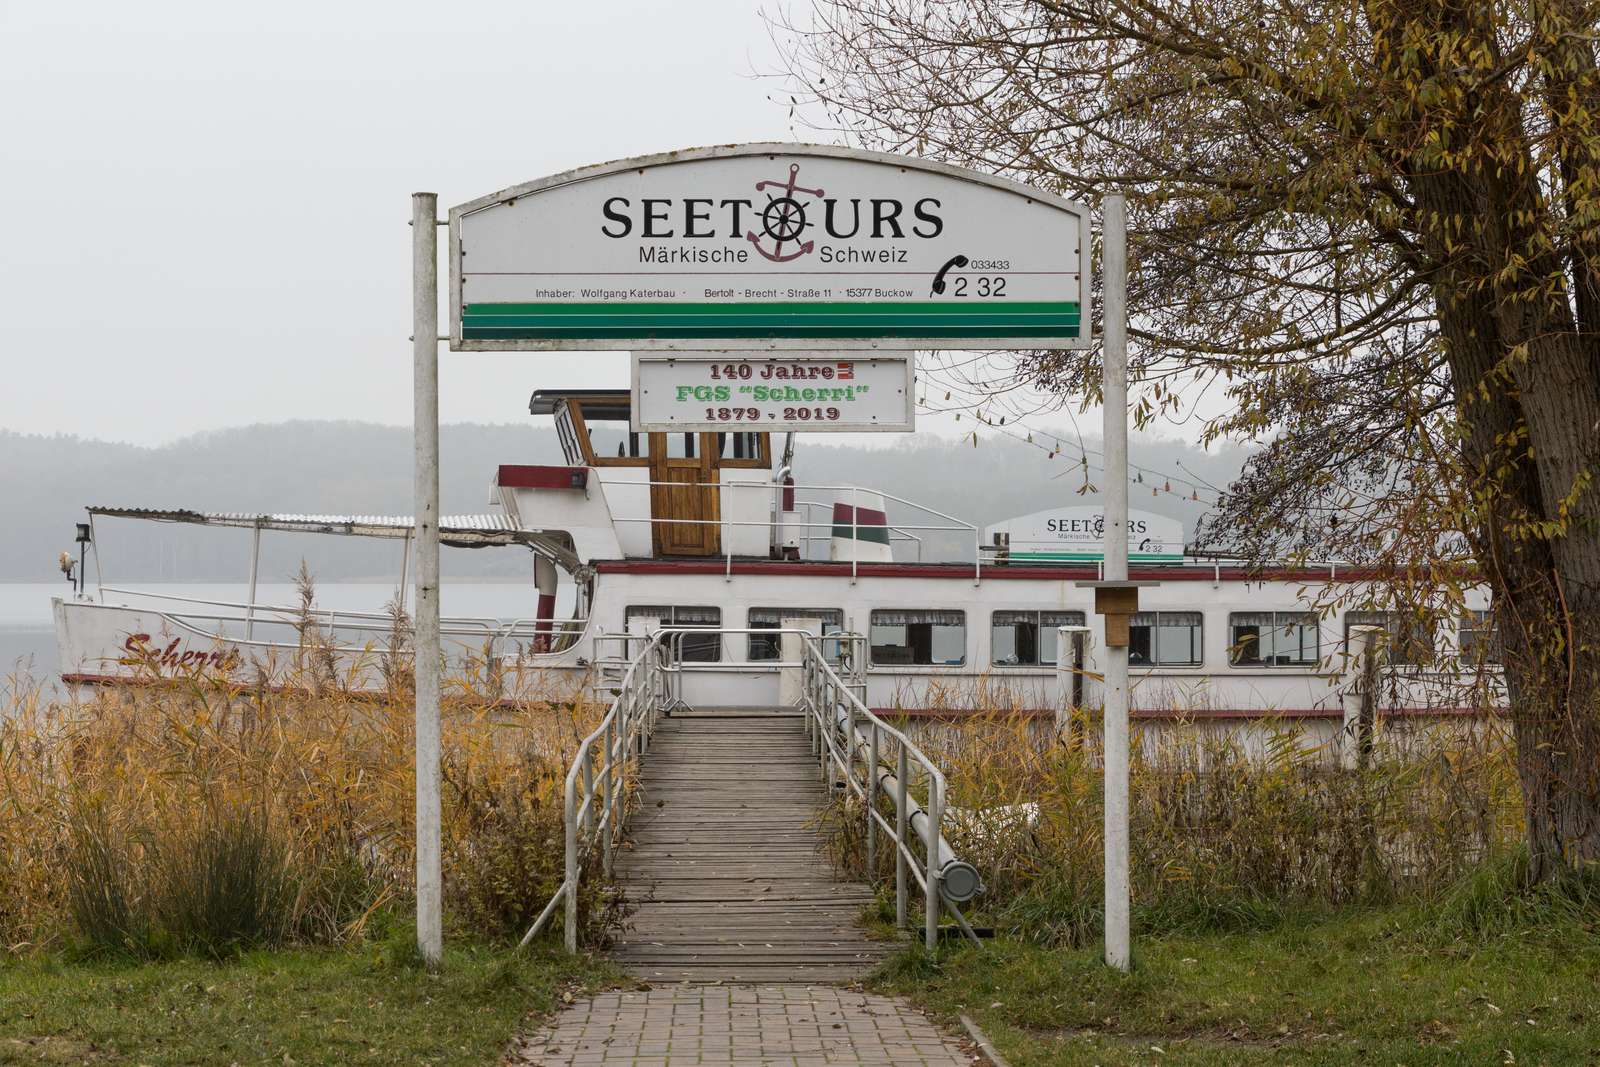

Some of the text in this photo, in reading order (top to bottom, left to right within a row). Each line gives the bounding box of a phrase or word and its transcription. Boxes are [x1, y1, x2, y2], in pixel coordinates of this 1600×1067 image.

[639, 245, 909, 264] Märkische Schweiz
[970, 259, 1010, 270] 033433
[535, 288, 576, 299] Inhaber:
[580, 288, 628, 300] Wolfgang
[629, 288, 676, 299] Katerbau
[704, 288, 734, 298] Bertolt
[744, 288, 777, 298] Brecht
[787, 288, 821, 299] Straße
[823, 288, 832, 298] 11
[845, 288, 873, 298] 15377
[874, 288, 914, 298] Buckow
[954, 276, 1007, 298] 2 32
[710, 364, 835, 380] 140 Jahre
[675, 385, 731, 402] FGS
[705, 407, 761, 421] 1879
[783, 407, 841, 421] 2019
[1047, 518, 1147, 534] SEETORS
